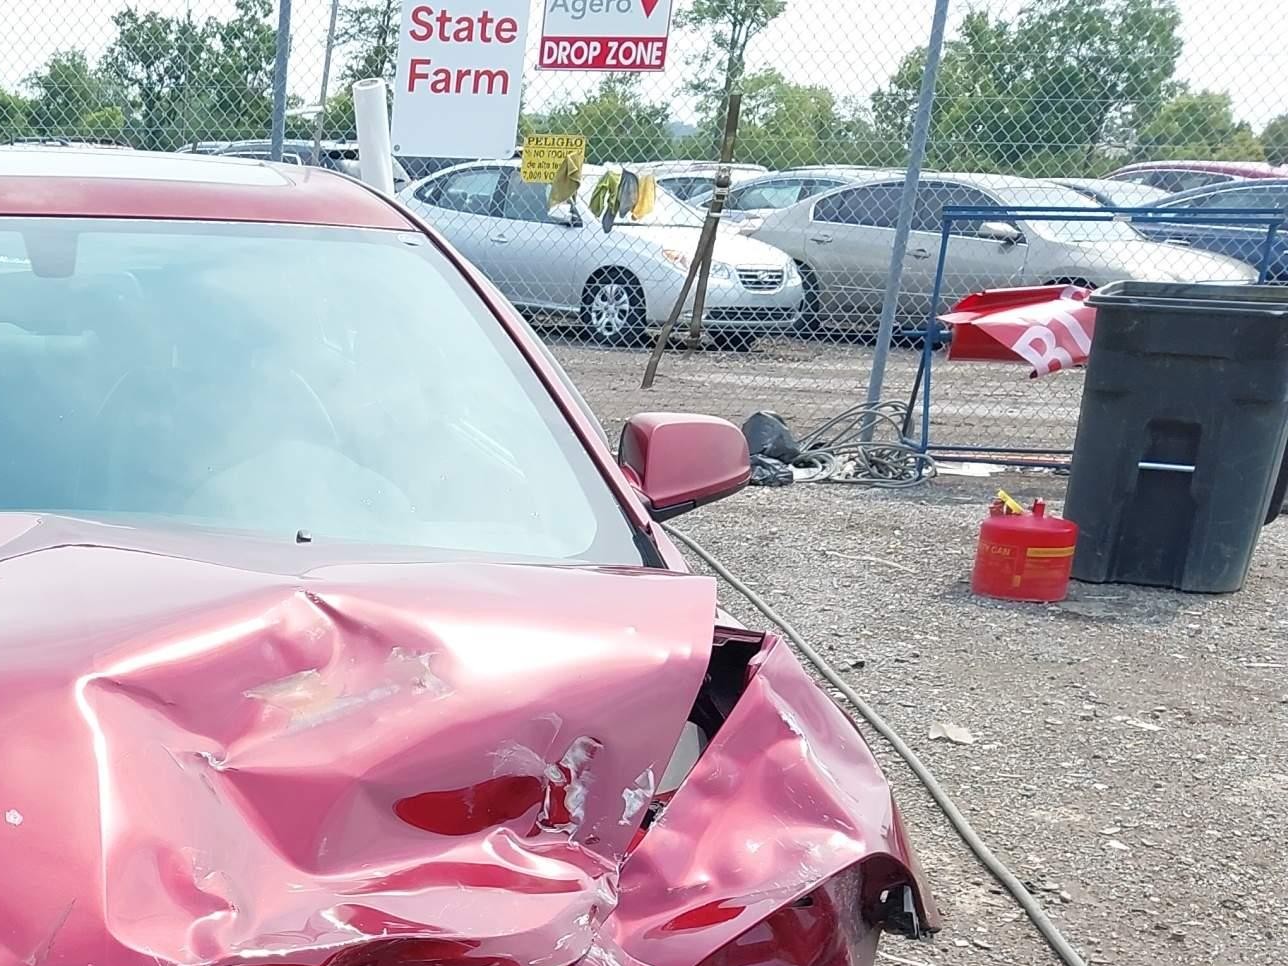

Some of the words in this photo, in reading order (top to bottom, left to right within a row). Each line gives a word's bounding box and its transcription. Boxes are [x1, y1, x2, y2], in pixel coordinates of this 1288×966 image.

[550, 0, 632, 20] Agero
[409, 5, 518, 44] State
[543, 40, 601, 65] DROP
[605, 41, 664, 65] ZONE
[408, 58, 510, 95] Farm
[528, 136, 583, 147] PELIGRO
